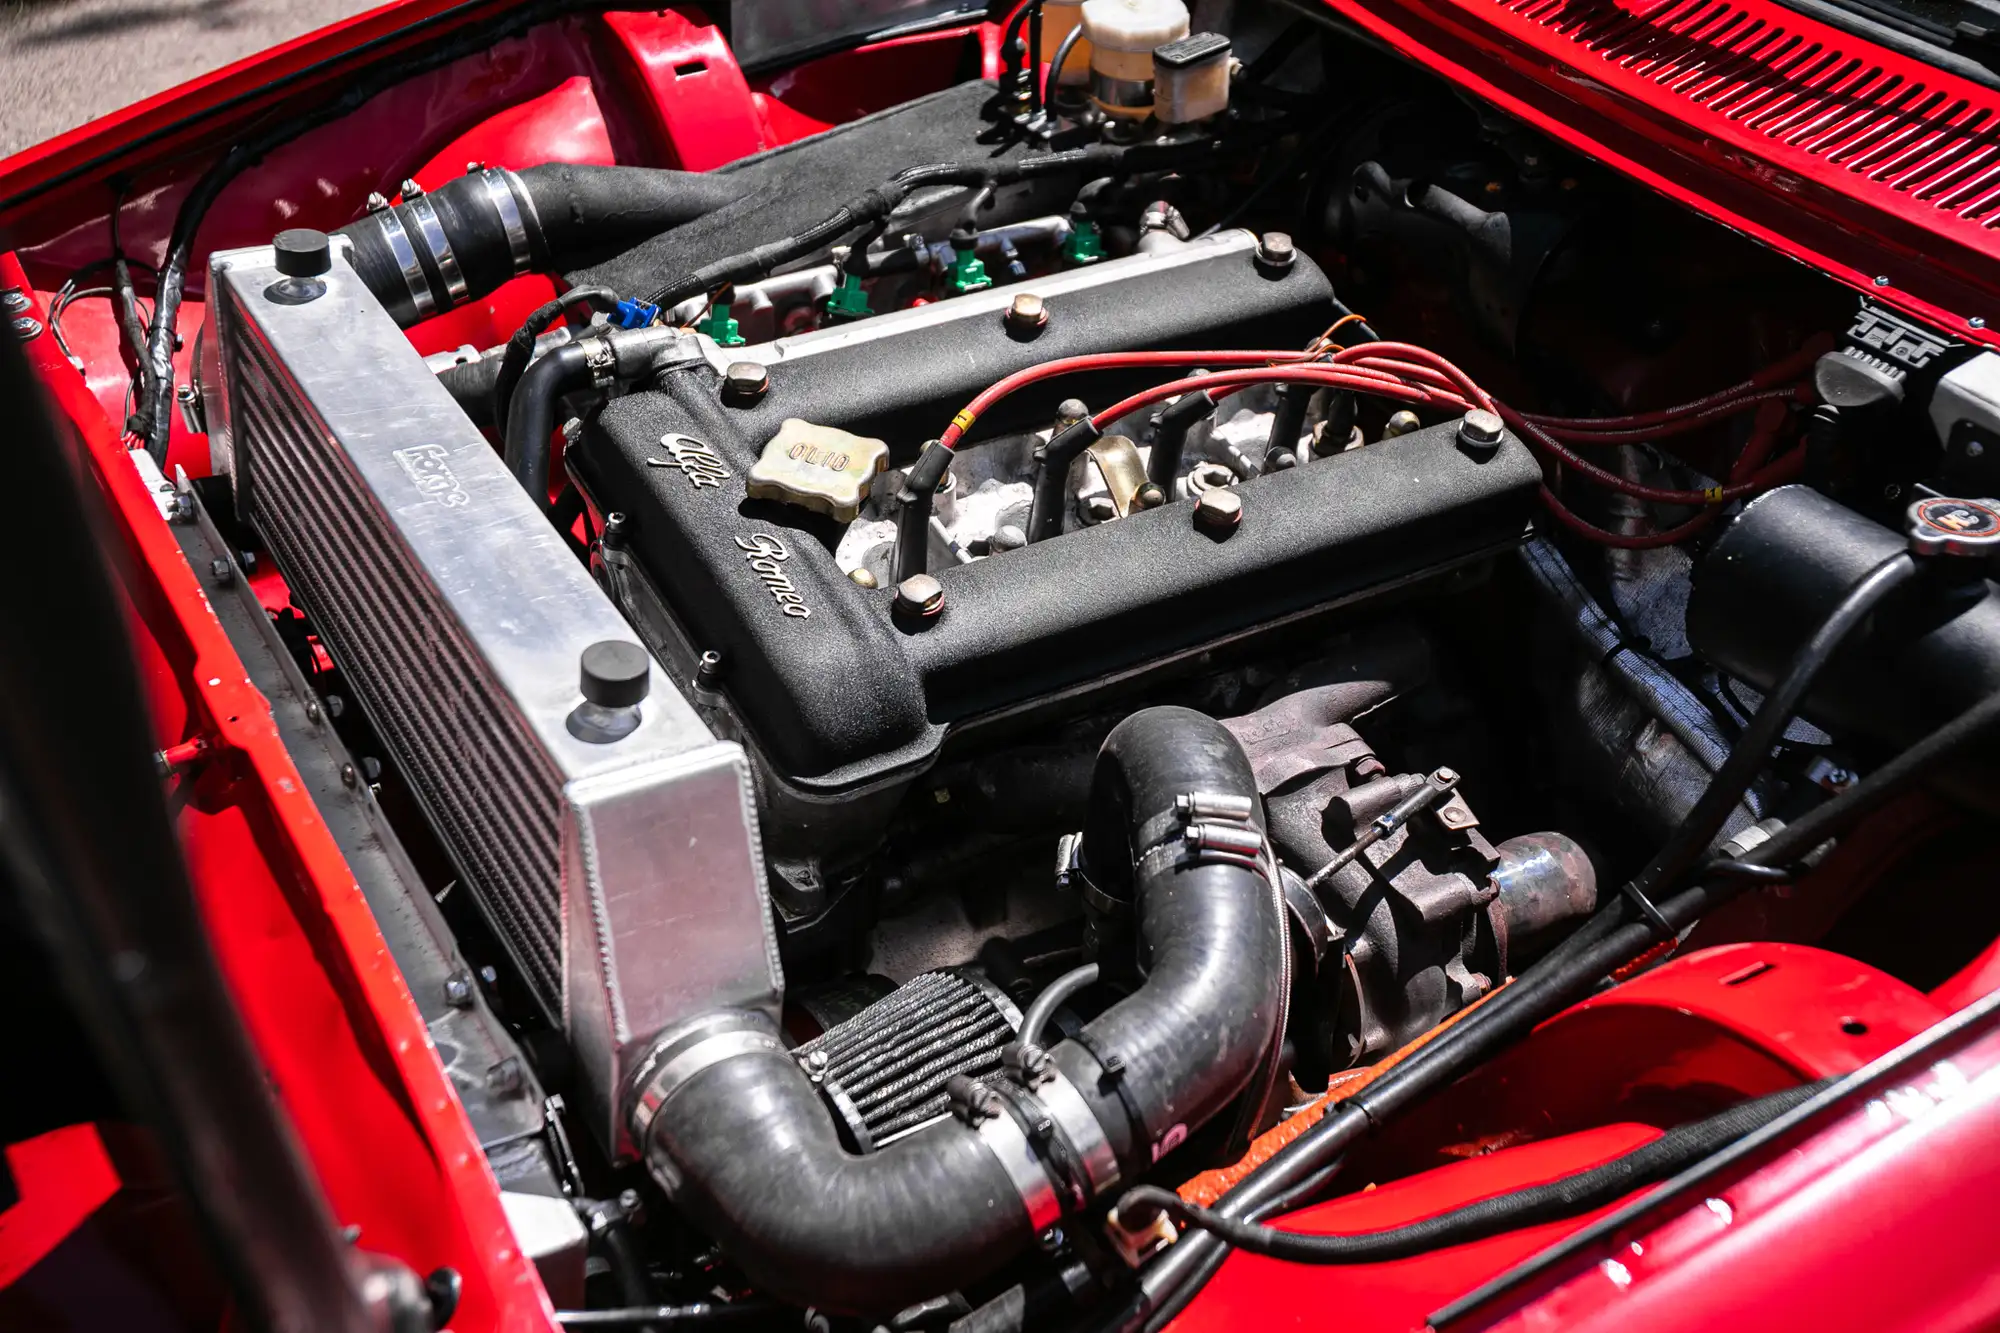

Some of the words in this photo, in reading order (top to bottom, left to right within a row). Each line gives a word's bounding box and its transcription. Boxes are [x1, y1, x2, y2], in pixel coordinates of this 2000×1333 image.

[647, 433, 731, 489] Alfa
[788, 443, 850, 472] OLIO
[1523, 420, 1564, 452] MAGNECOR
[1577, 457, 1623, 486] COMPETITION
[734, 533, 812, 620] Romeo
